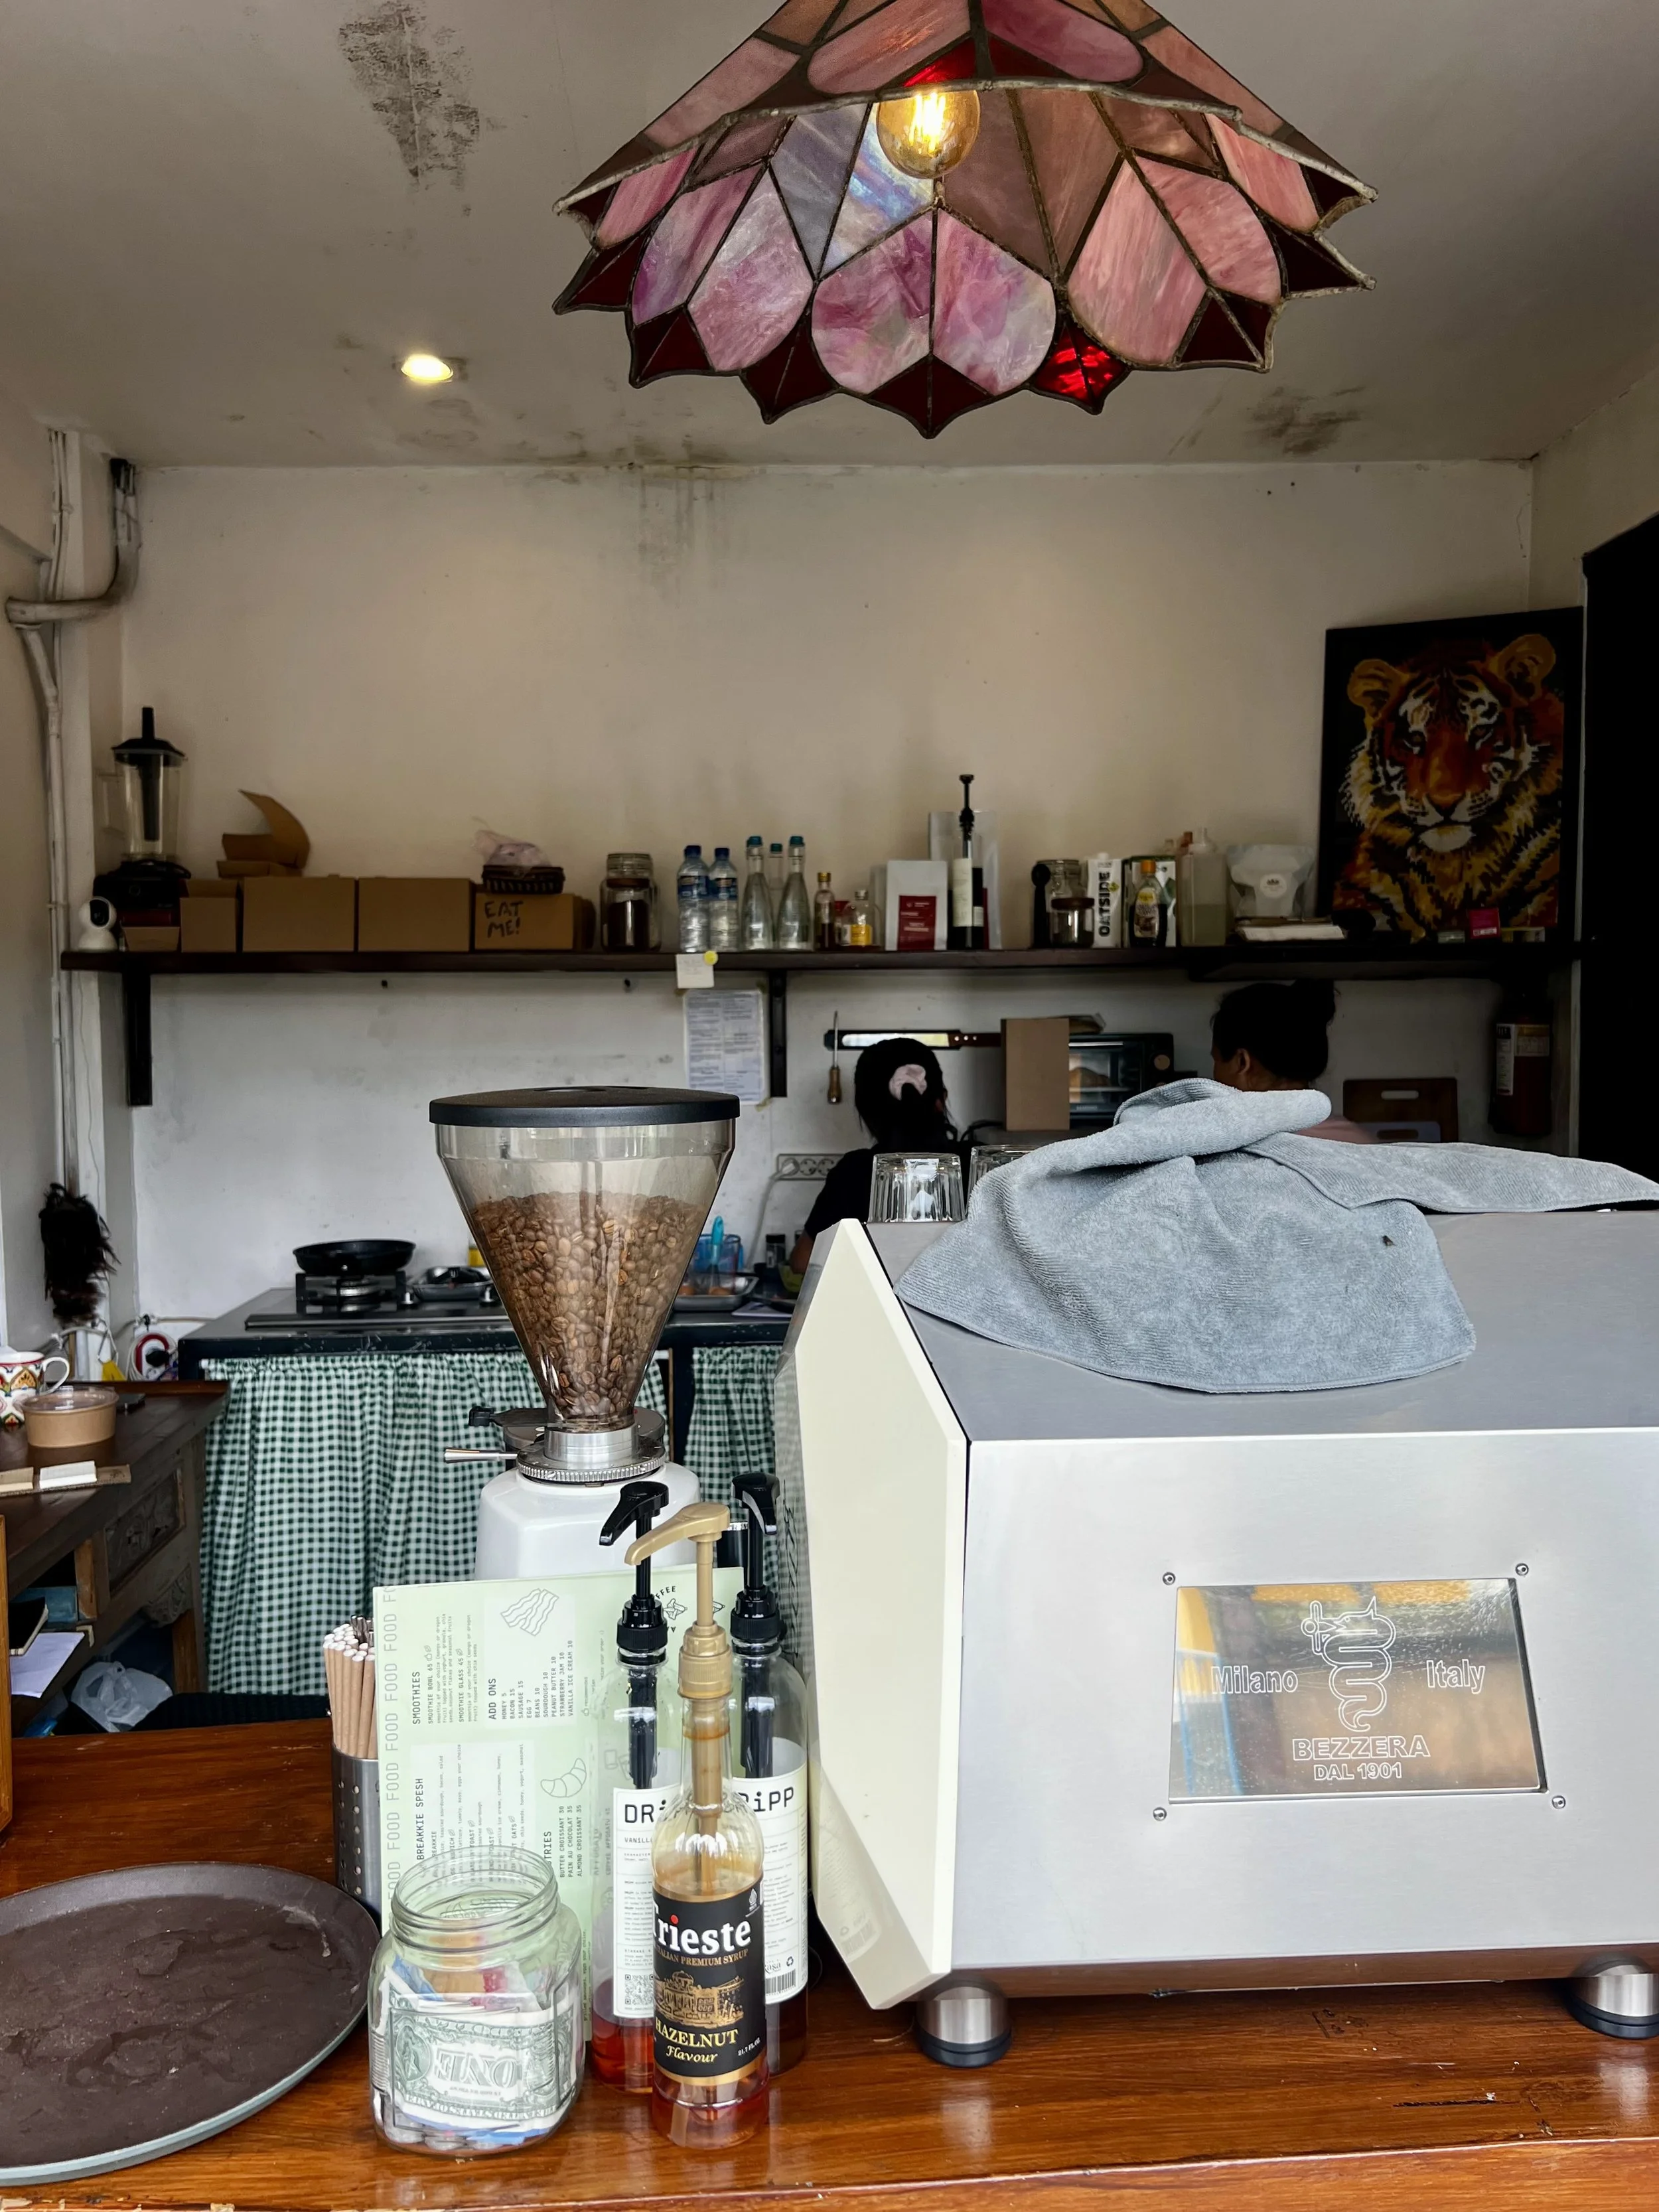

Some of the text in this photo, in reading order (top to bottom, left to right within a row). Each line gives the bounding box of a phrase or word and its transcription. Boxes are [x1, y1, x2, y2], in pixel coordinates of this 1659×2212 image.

[484, 900, 524, 919] EAT
[1098, 872, 1110, 936] OATSIDE
[488, 917, 520, 938] ME!
[655, 1585, 676, 1599] FFEE
[384, 1614, 397, 1651] FOOD
[384, 1663, 397, 1701] FOOD
[1211, 1659, 1485, 1694] Milano Italy
[412, 1672, 421, 1724] SMOOTHIES
[385, 1713, 398, 1751] FOOD
[1292, 1734, 1431, 1761] BEZZERA
[386, 1763, 399, 1800] FOOD
[1314, 1762, 1402, 1781] DAL 1901
[387, 1812, 400, 1850] FOOD
[543, 1831, 552, 1864] TRIES
[681, 1956, 722, 1966] PREMIUM
[723, 1949, 749, 1965] SYRUP
[656, 2017, 739, 2047] HAZELNUT
[435, 2047, 523, 2089] ONE
[666, 2045, 718, 2063] Flavour
[448, 2105, 492, 2117] STATES
